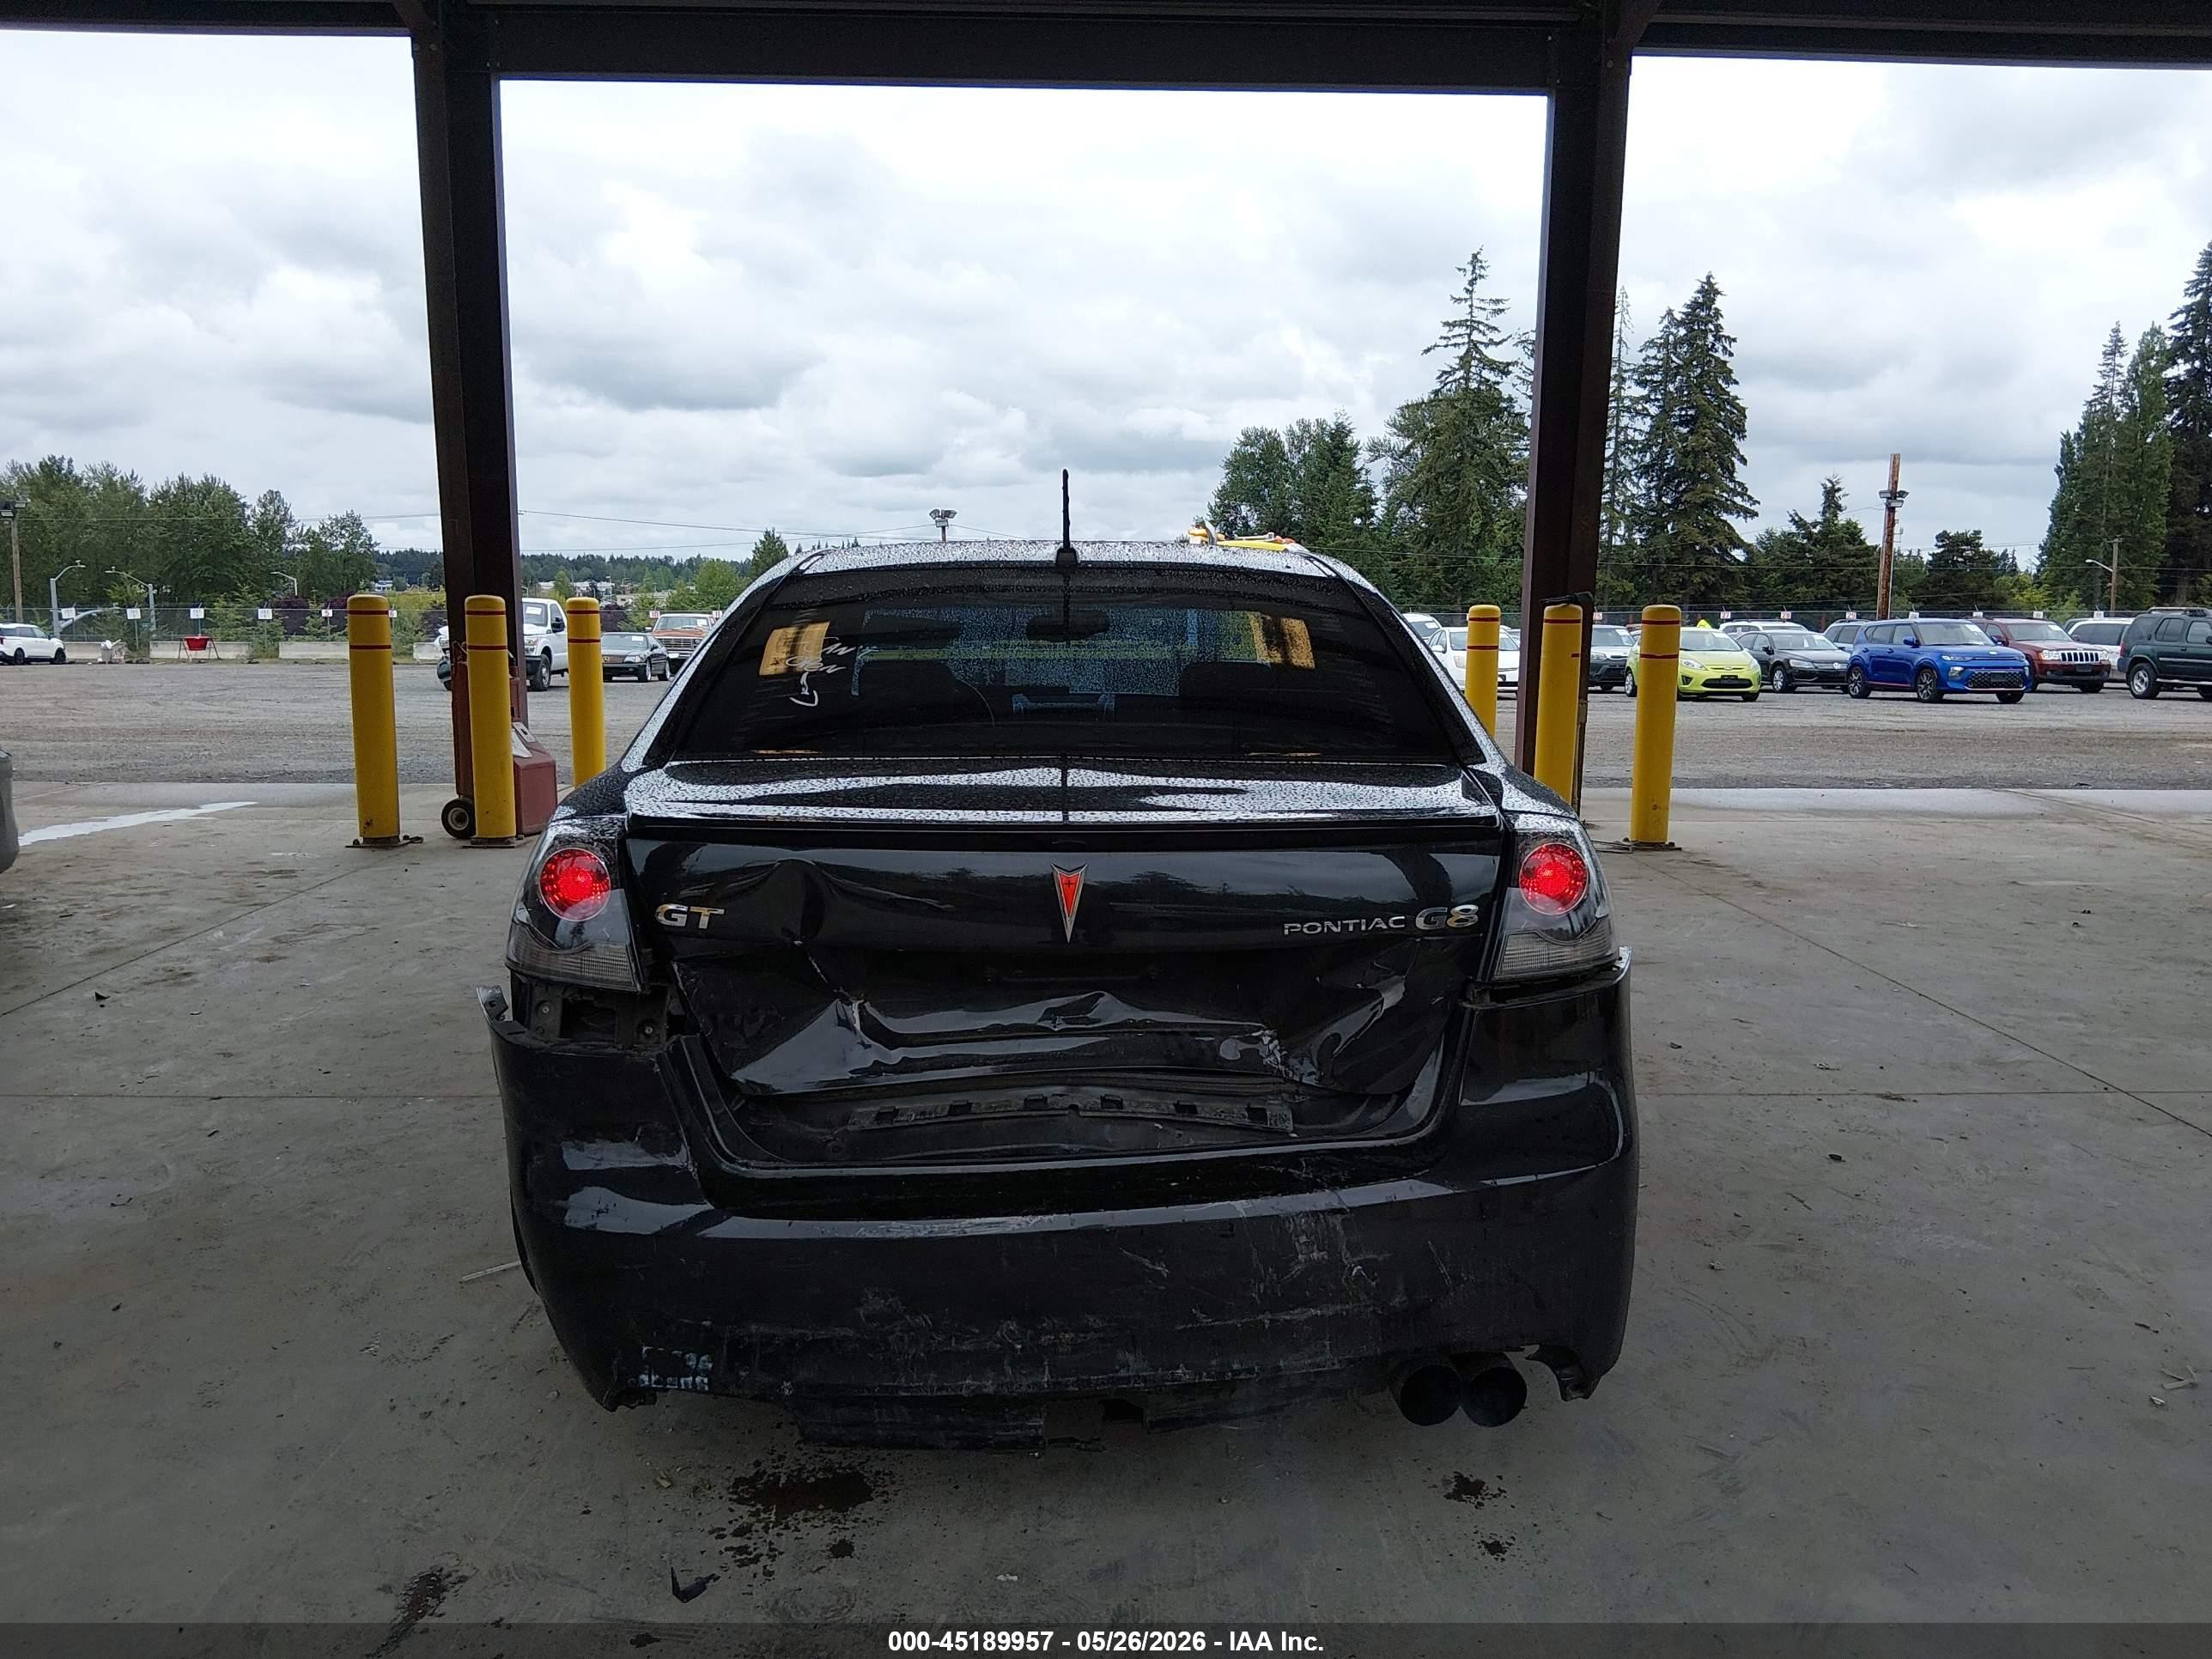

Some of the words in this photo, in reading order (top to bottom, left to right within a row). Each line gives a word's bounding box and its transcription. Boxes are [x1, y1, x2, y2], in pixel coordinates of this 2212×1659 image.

[655, 903, 725, 929] GT
[1284, 915, 1406, 936] PONTIAC
[1416, 904, 1479, 931] G8
